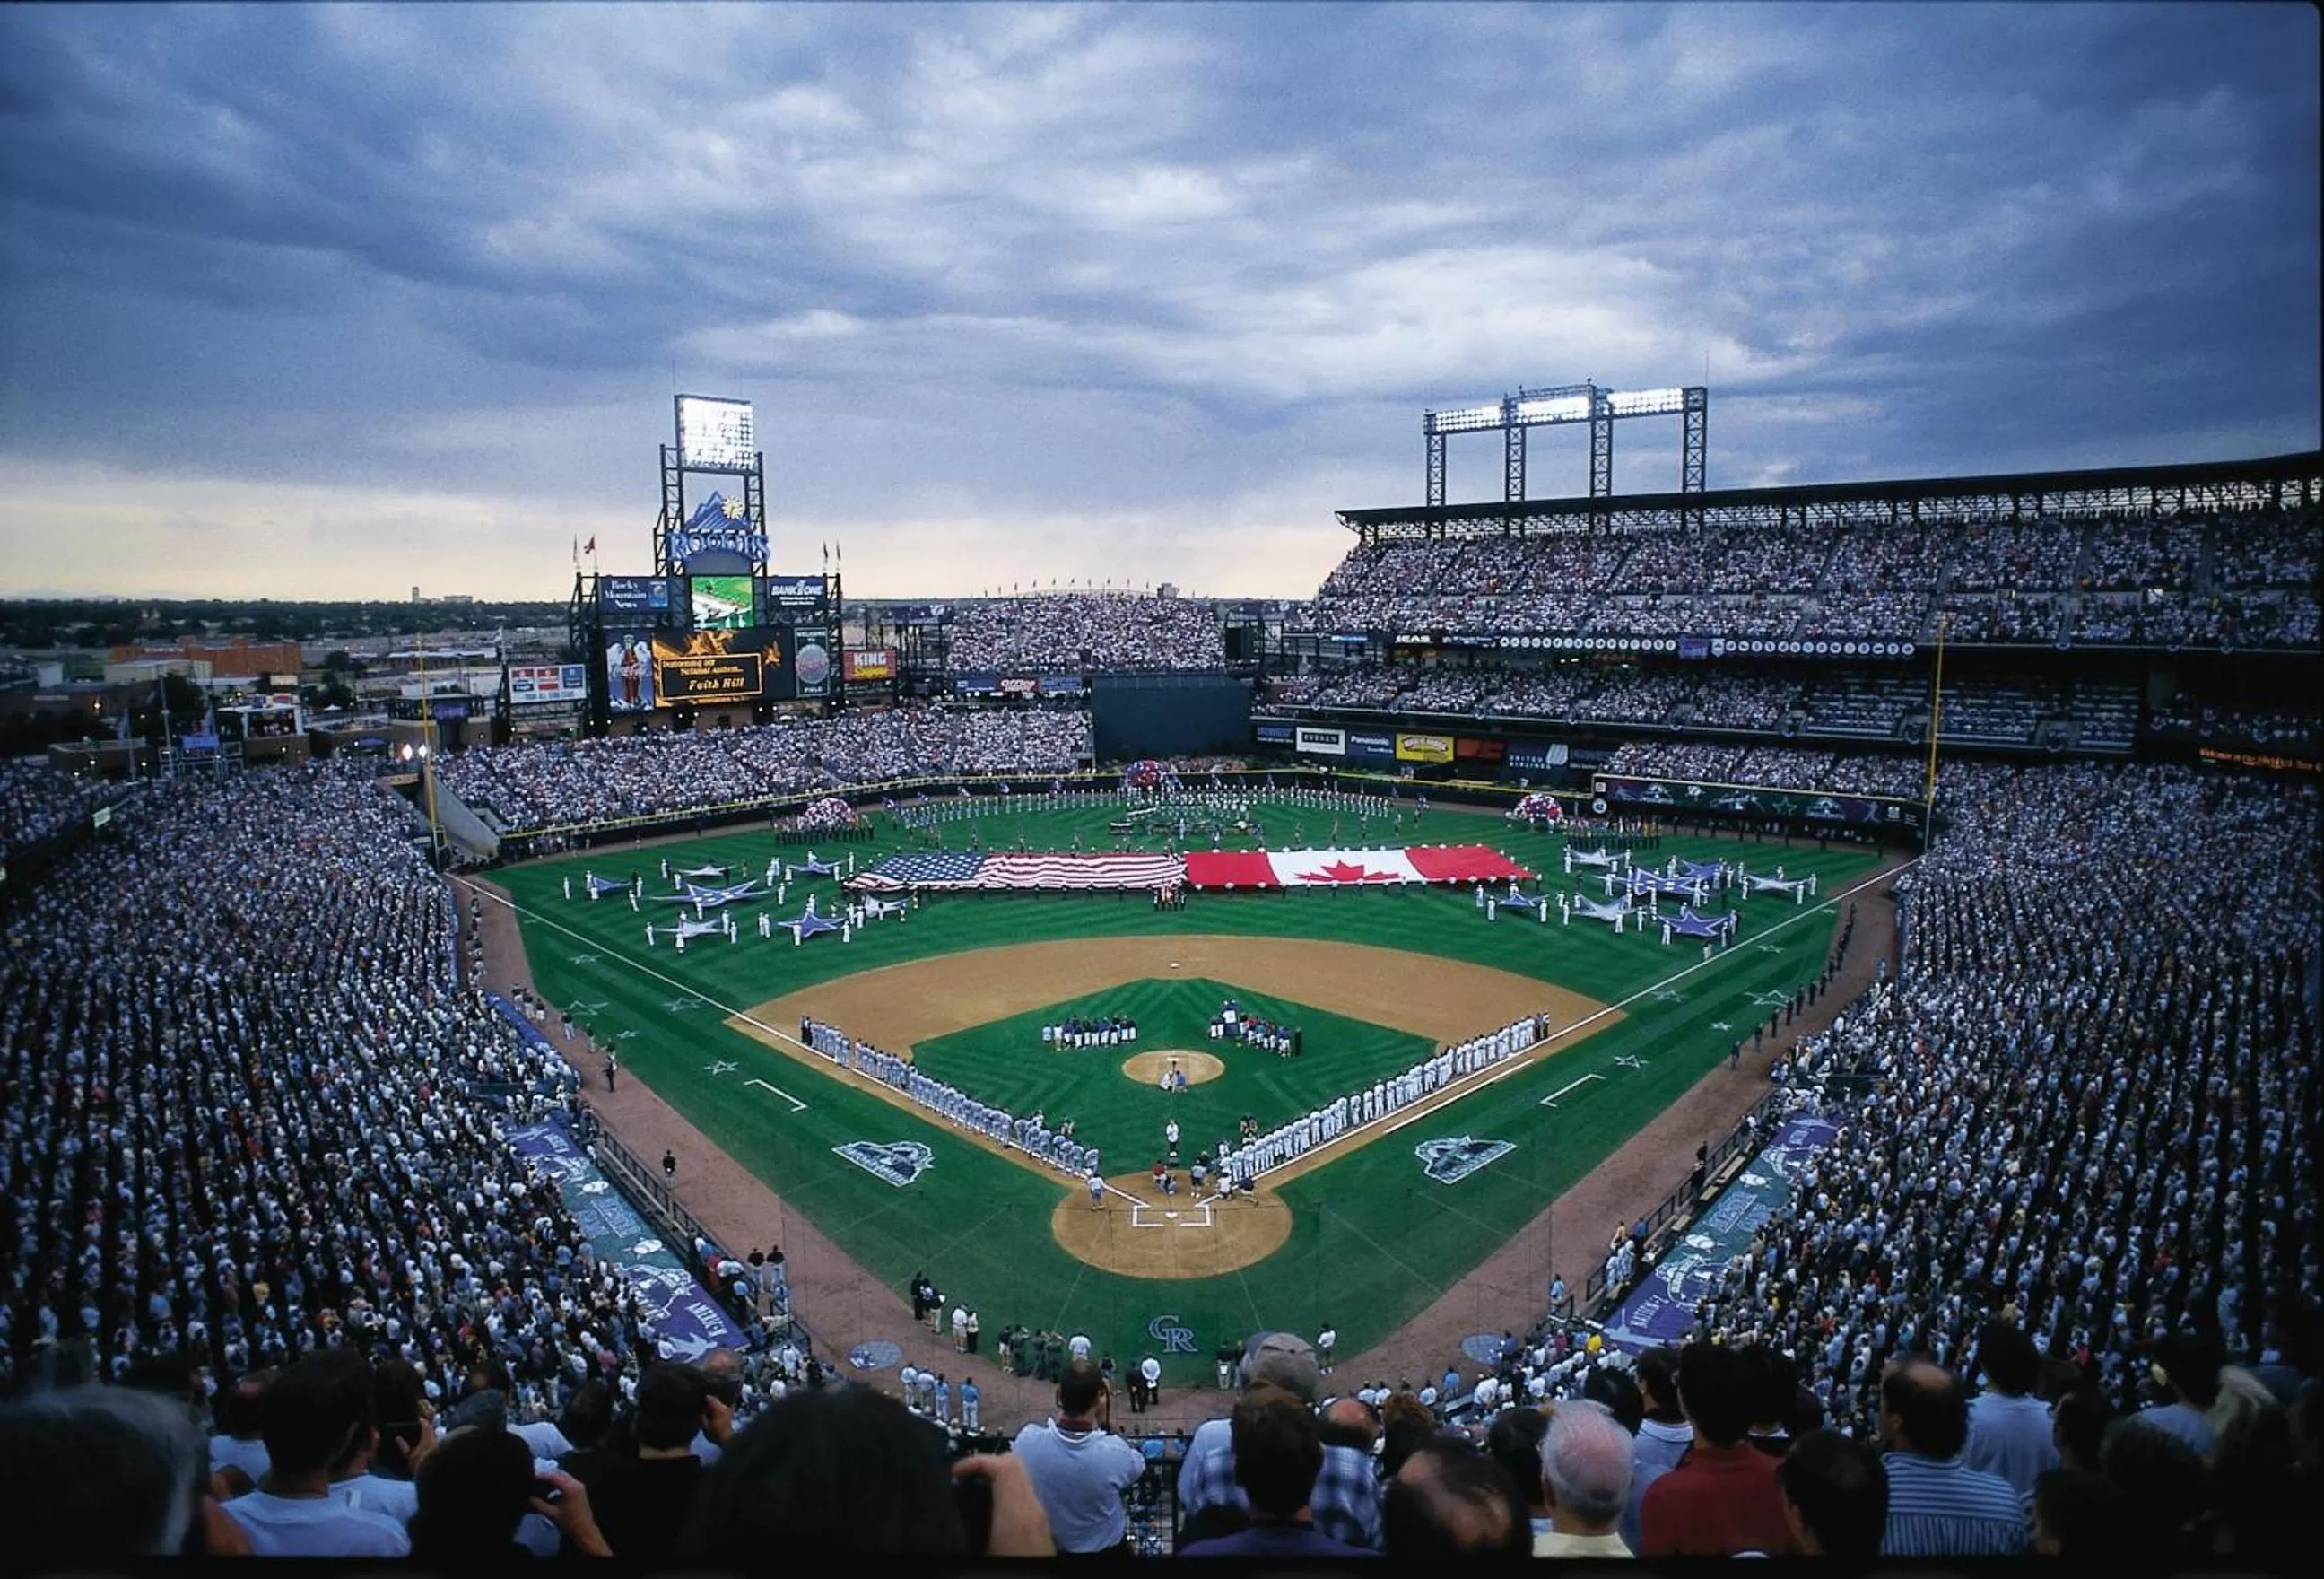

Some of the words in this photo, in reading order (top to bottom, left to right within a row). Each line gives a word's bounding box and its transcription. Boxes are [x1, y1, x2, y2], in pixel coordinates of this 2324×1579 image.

[605, 589, 647, 599] Mountain
[854, 651, 887, 666] KING
[688, 678, 720, 691] Faith
[1350, 735, 1390, 746] Panasonic
[1148, 1314, 1199, 1354] CR
